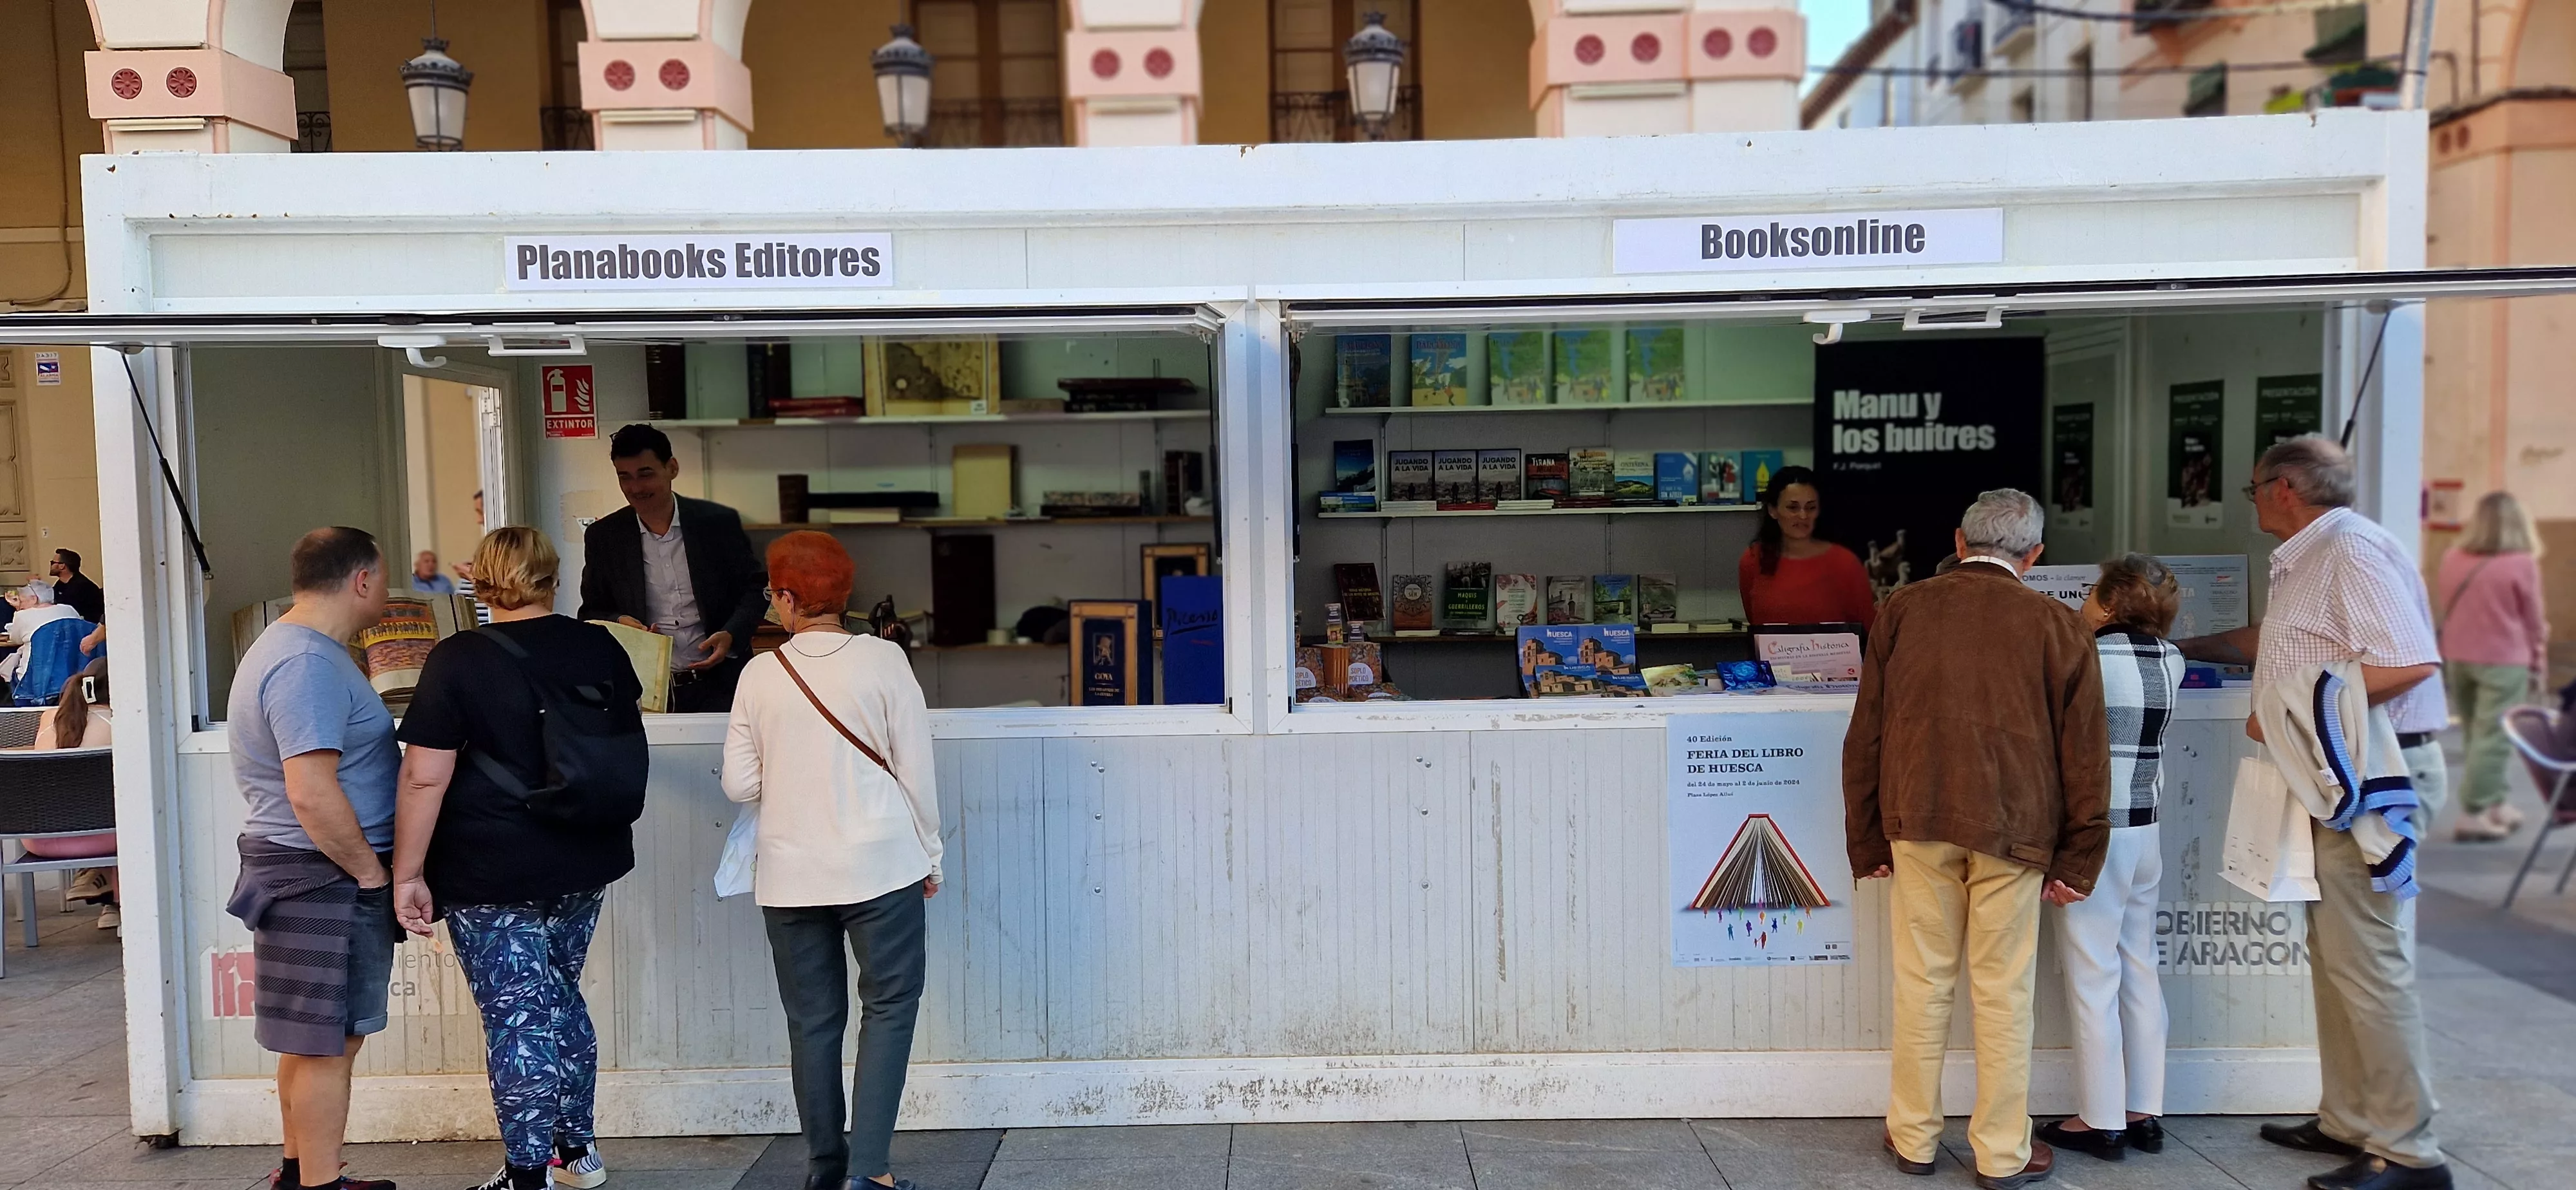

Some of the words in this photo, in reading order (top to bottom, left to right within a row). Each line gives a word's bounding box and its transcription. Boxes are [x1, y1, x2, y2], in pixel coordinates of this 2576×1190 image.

[1701, 219, 1926, 260] Booksonline
[517, 243, 726, 280] Planabooks
[735, 241, 881, 278] Editores
[1833, 390, 1918, 420] Manu
[1923, 392, 1942, 421] y
[546, 419, 594, 430] EXTINTOR
[1833, 423, 1879, 454] los
[1884, 422, 1996, 453] buitres
[1687, 750, 1728, 760] FERIA
[1731, 749, 1759, 759] DEL
[1761, 748, 1804, 758] LIBRO
[1687, 765, 1705, 774] DE
[1708, 763, 1764, 773] HUESCA
[2155, 911, 2291, 936] OBIERNO
[2157, 941, 2168, 965] E
